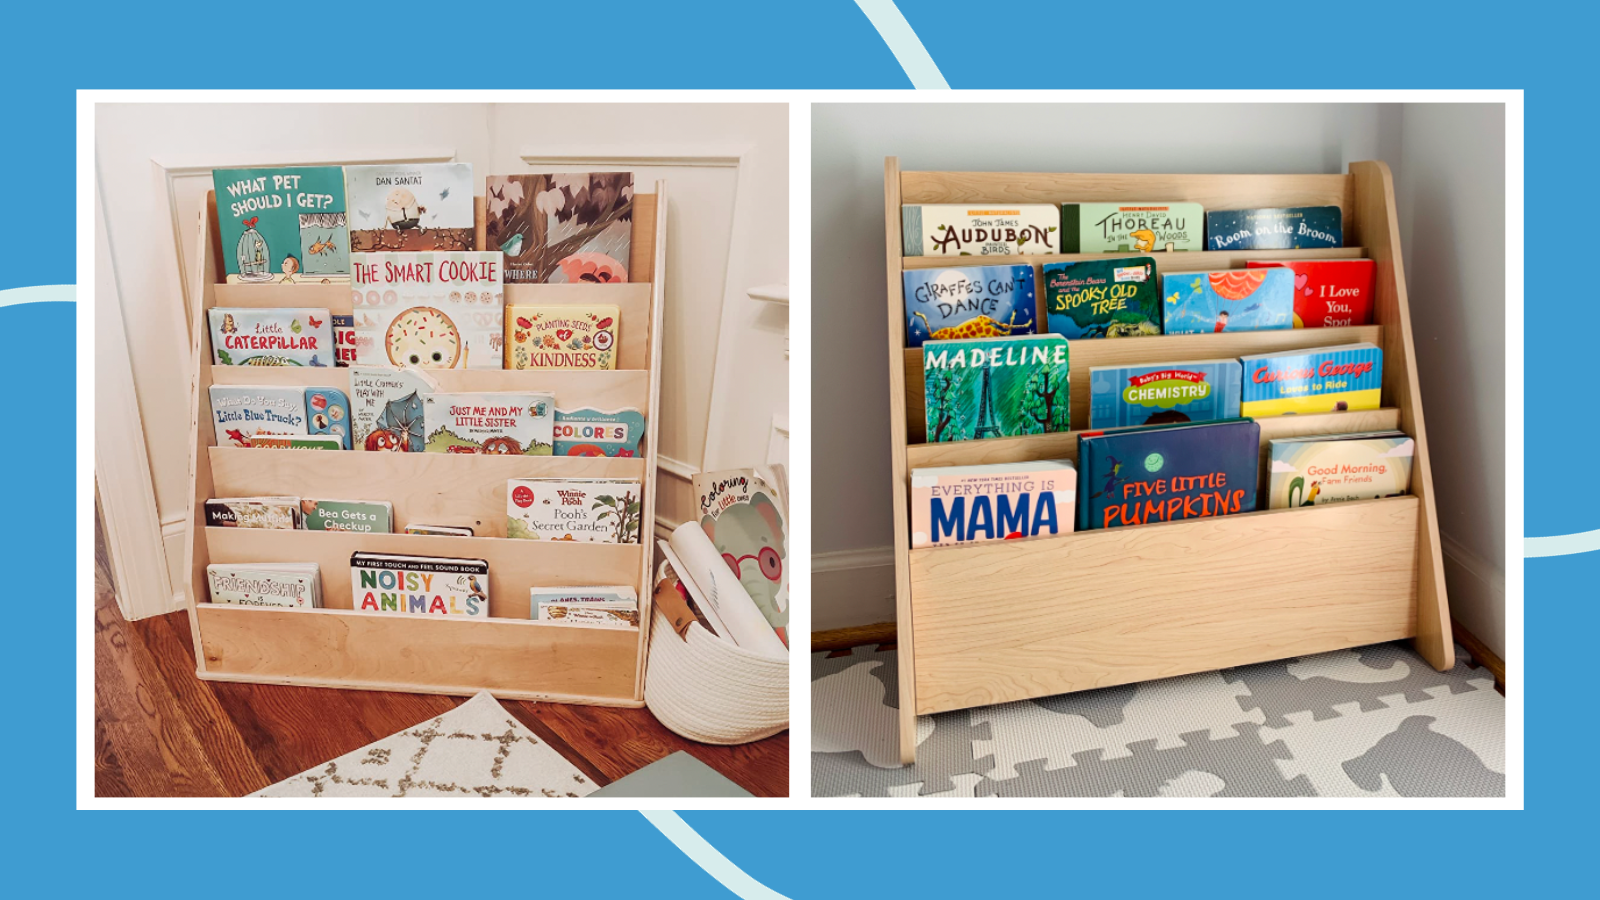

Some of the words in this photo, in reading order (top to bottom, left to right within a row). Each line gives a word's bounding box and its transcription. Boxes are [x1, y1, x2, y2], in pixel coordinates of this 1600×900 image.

[227, 177, 267, 198] WHAT
[273, 175, 301, 190] PET
[376, 178, 392, 186] DAN
[395, 177, 422, 186] SANTAT
[231, 194, 283, 217] SHOULD
[287, 193, 292, 207] I
[297, 193, 334, 209] GET?
[972, 219, 992, 227] JOHN
[995, 219, 1019, 227] JAMES
[1095, 212, 1185, 239] THOREAU
[931, 225, 1053, 254] AUDUBON
[1156, 231, 1189, 242] WOODS
[1215, 230, 1252, 248] Room
[1256, 225, 1272, 236] on
[1274, 223, 1294, 234] the
[1298, 222, 1337, 244] Broom
[981, 246, 1011, 255] BIRDS
[353, 263, 379, 284] THE
[385, 261, 433, 283] SMART
[439, 260, 497, 283] COOKIE
[505, 270, 538, 280] WHERE
[1050, 279, 1084, 288] Berenstain
[1086, 277, 1106, 285] Bears
[915, 280, 983, 303] GIRAFFES
[988, 276, 1026, 296] CAN'T
[1319, 285, 1325, 298] I
[1329, 285, 1360, 298] Love
[1056, 287, 1108, 311] SPOOKY
[1110, 284, 1138, 299] OLD
[937, 298, 999, 319] DANCE
[1091, 298, 1128, 315] TREE
[1326, 301, 1352, 314] You,
[255, 323, 283, 334] Little
[536, 319, 570, 332] PLANTING
[571, 320, 593, 332] SEEDS
[1324, 316, 1352, 328] Spot
[530, 352, 597, 368] KINDNESS
[926, 345, 1067, 370] MADELINE
[1139, 374, 1159, 384] Baby's
[1161, 372, 1172, 380] Big
[1252, 366, 1315, 384] Curious
[1318, 360, 1373, 378] George
[1128, 385, 1207, 401] CHEMISTRY
[1280, 386, 1309, 394] Loves
[1312, 383, 1323, 391] to
[1326, 381, 1348, 389] Ride
[217, 397, 242, 408] What
[243, 396, 256, 406] Do
[258, 395, 276, 407] You
[278, 399, 298, 412] Say,
[366, 399, 376, 407] ME
[217, 410, 243, 423] Little
[243, 409, 265, 421] Blue
[265, 410, 302, 427] Truck?
[450, 406, 471, 416] JUST
[473, 406, 487, 416] ME
[488, 407, 508, 417] AND
[509, 406, 524, 416] MY
[456, 417, 484, 427] LITTLE
[485, 418, 517, 428] SISTER
[553, 425, 624, 439] COLORES
[1308, 464, 1338, 476] Good
[1341, 463, 1387, 475] Morning,
[1123, 479, 1167, 500] FIVE
[1171, 473, 1227, 493] LITTLE
[1322, 477, 1342, 485] Farm
[1344, 475, 1372, 484] Friends
[557, 491, 587, 499] Winnie
[701, 477, 749, 510] Coloring
[931, 482, 1035, 497] EVERYTHING
[1041, 480, 1055, 491] IS
[561, 498, 583, 506] Pooh
[319, 509, 338, 518] Bea
[342, 510, 367, 521] Gets
[554, 509, 588, 520] Pooh's
[1104, 490, 1245, 529] PUMPKINS
[212, 512, 250, 523] Making
[930, 492, 1058, 543] MAMA
[324, 520, 372, 533] Checkup
[532, 521, 564, 531] Secret
[566, 521, 608, 532] Garden
[213, 576, 306, 598] FRIENDSHIP
[360, 570, 434, 592] NOISY
[361, 592, 480, 616] ANIMALS
